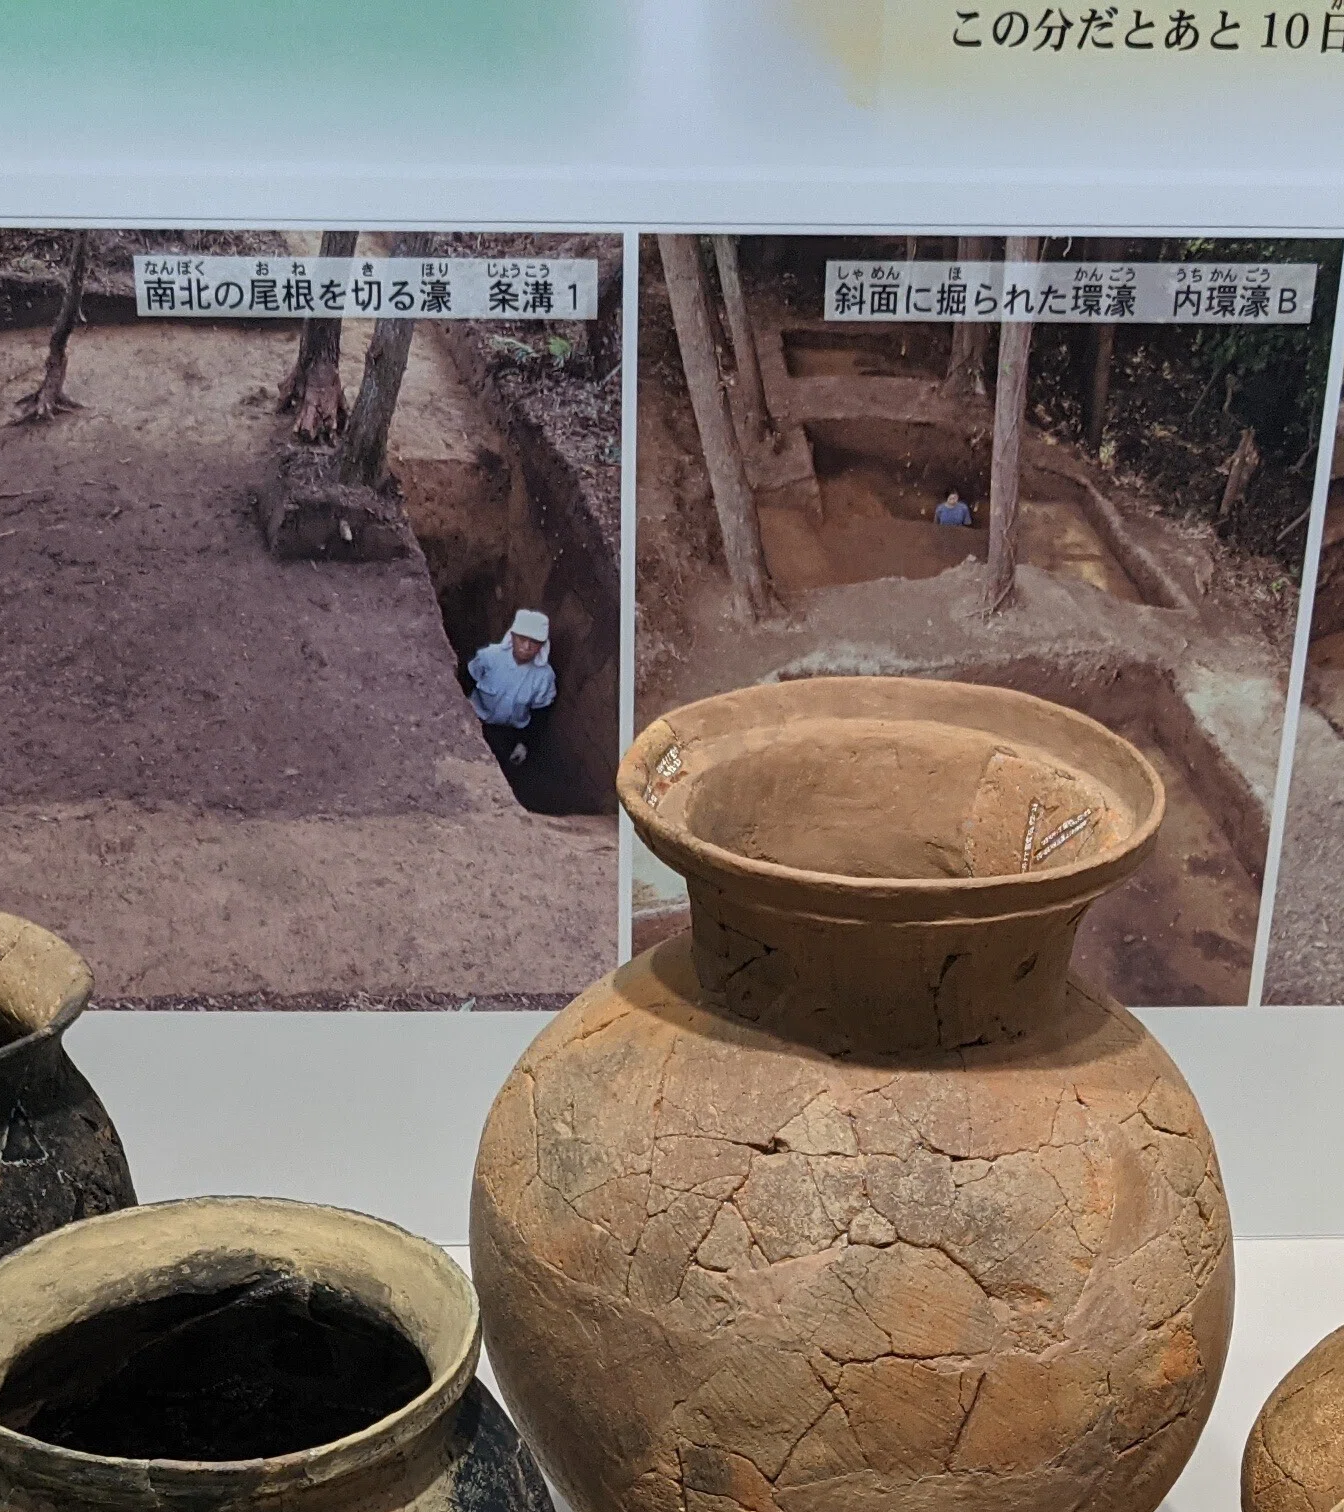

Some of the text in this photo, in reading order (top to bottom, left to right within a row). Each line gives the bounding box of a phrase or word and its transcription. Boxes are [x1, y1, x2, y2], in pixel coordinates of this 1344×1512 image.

[144, 277, 451, 312] 南北の尾根を切る濠
[836, 282, 1136, 316] 斜面に掘られた環濠
